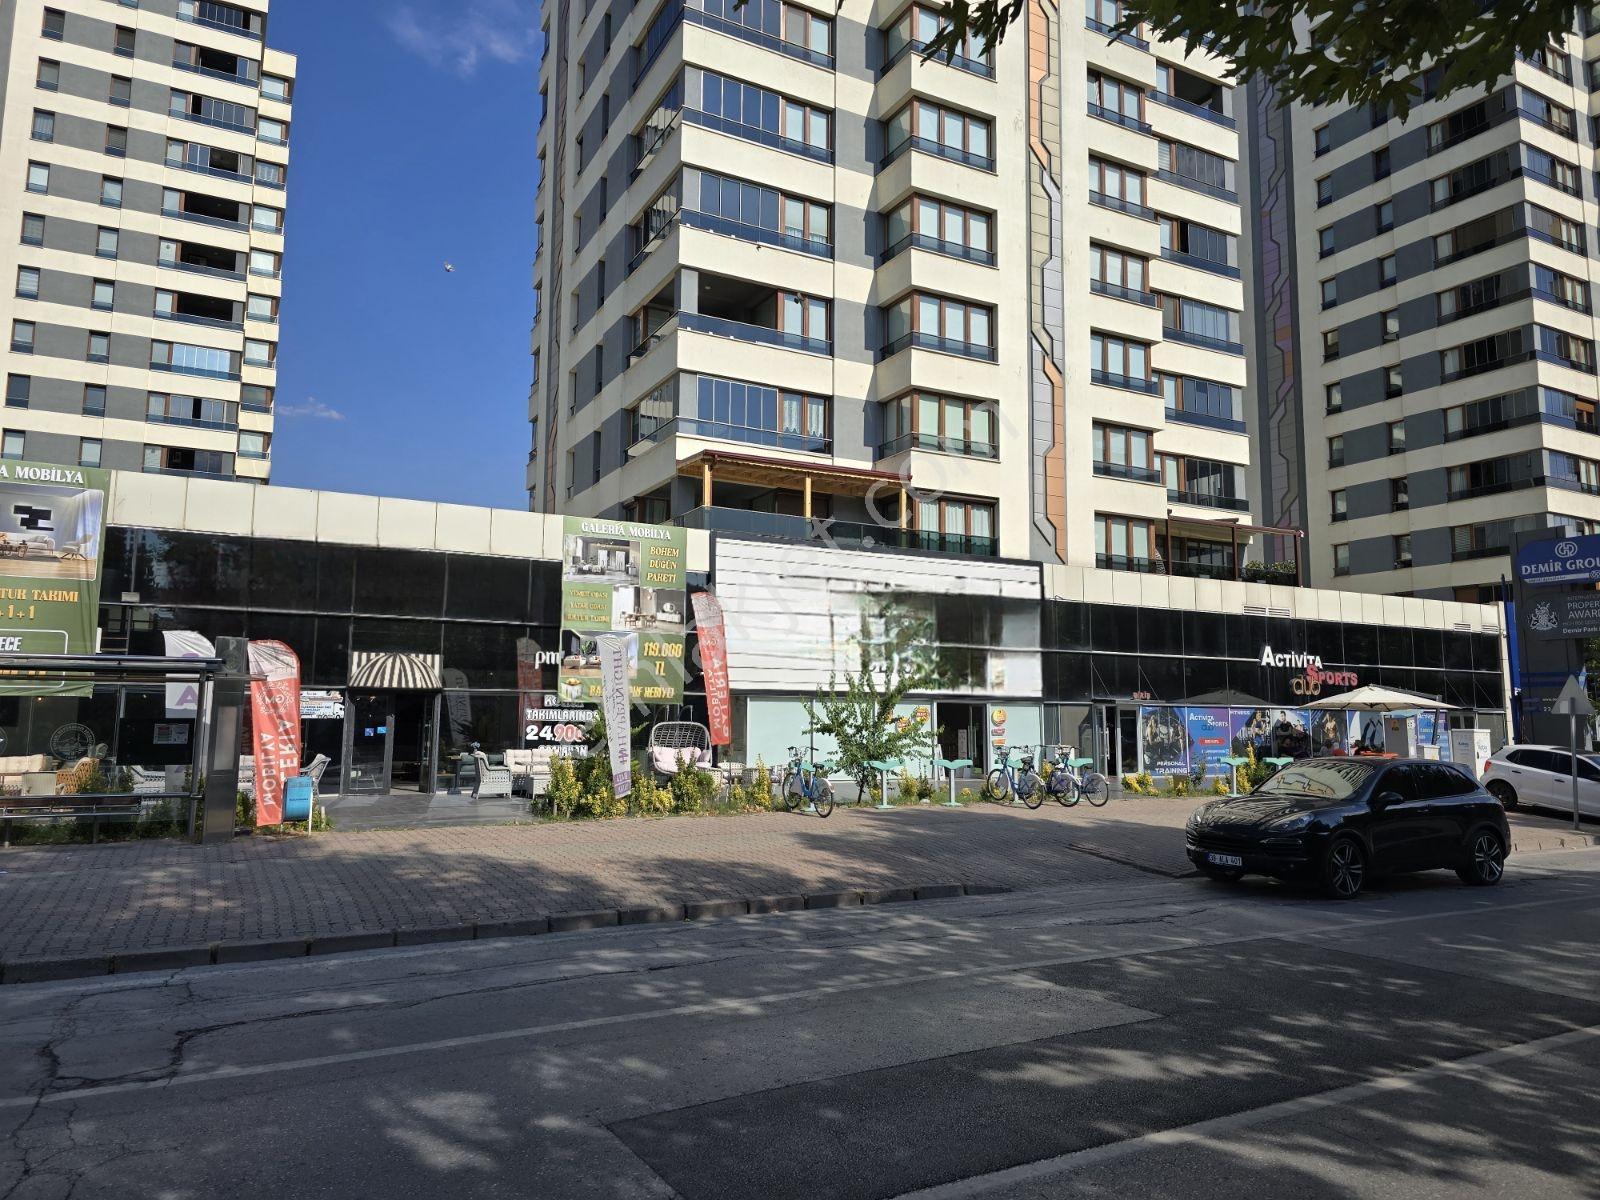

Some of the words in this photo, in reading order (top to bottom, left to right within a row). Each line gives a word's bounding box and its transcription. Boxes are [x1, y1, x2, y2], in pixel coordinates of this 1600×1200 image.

[15, 466, 84, 484] MOBİLYA
[650, 546, 679, 558] BOHEM
[1522, 560, 1562, 575] DEMİR
[654, 661, 666, 677] TL
